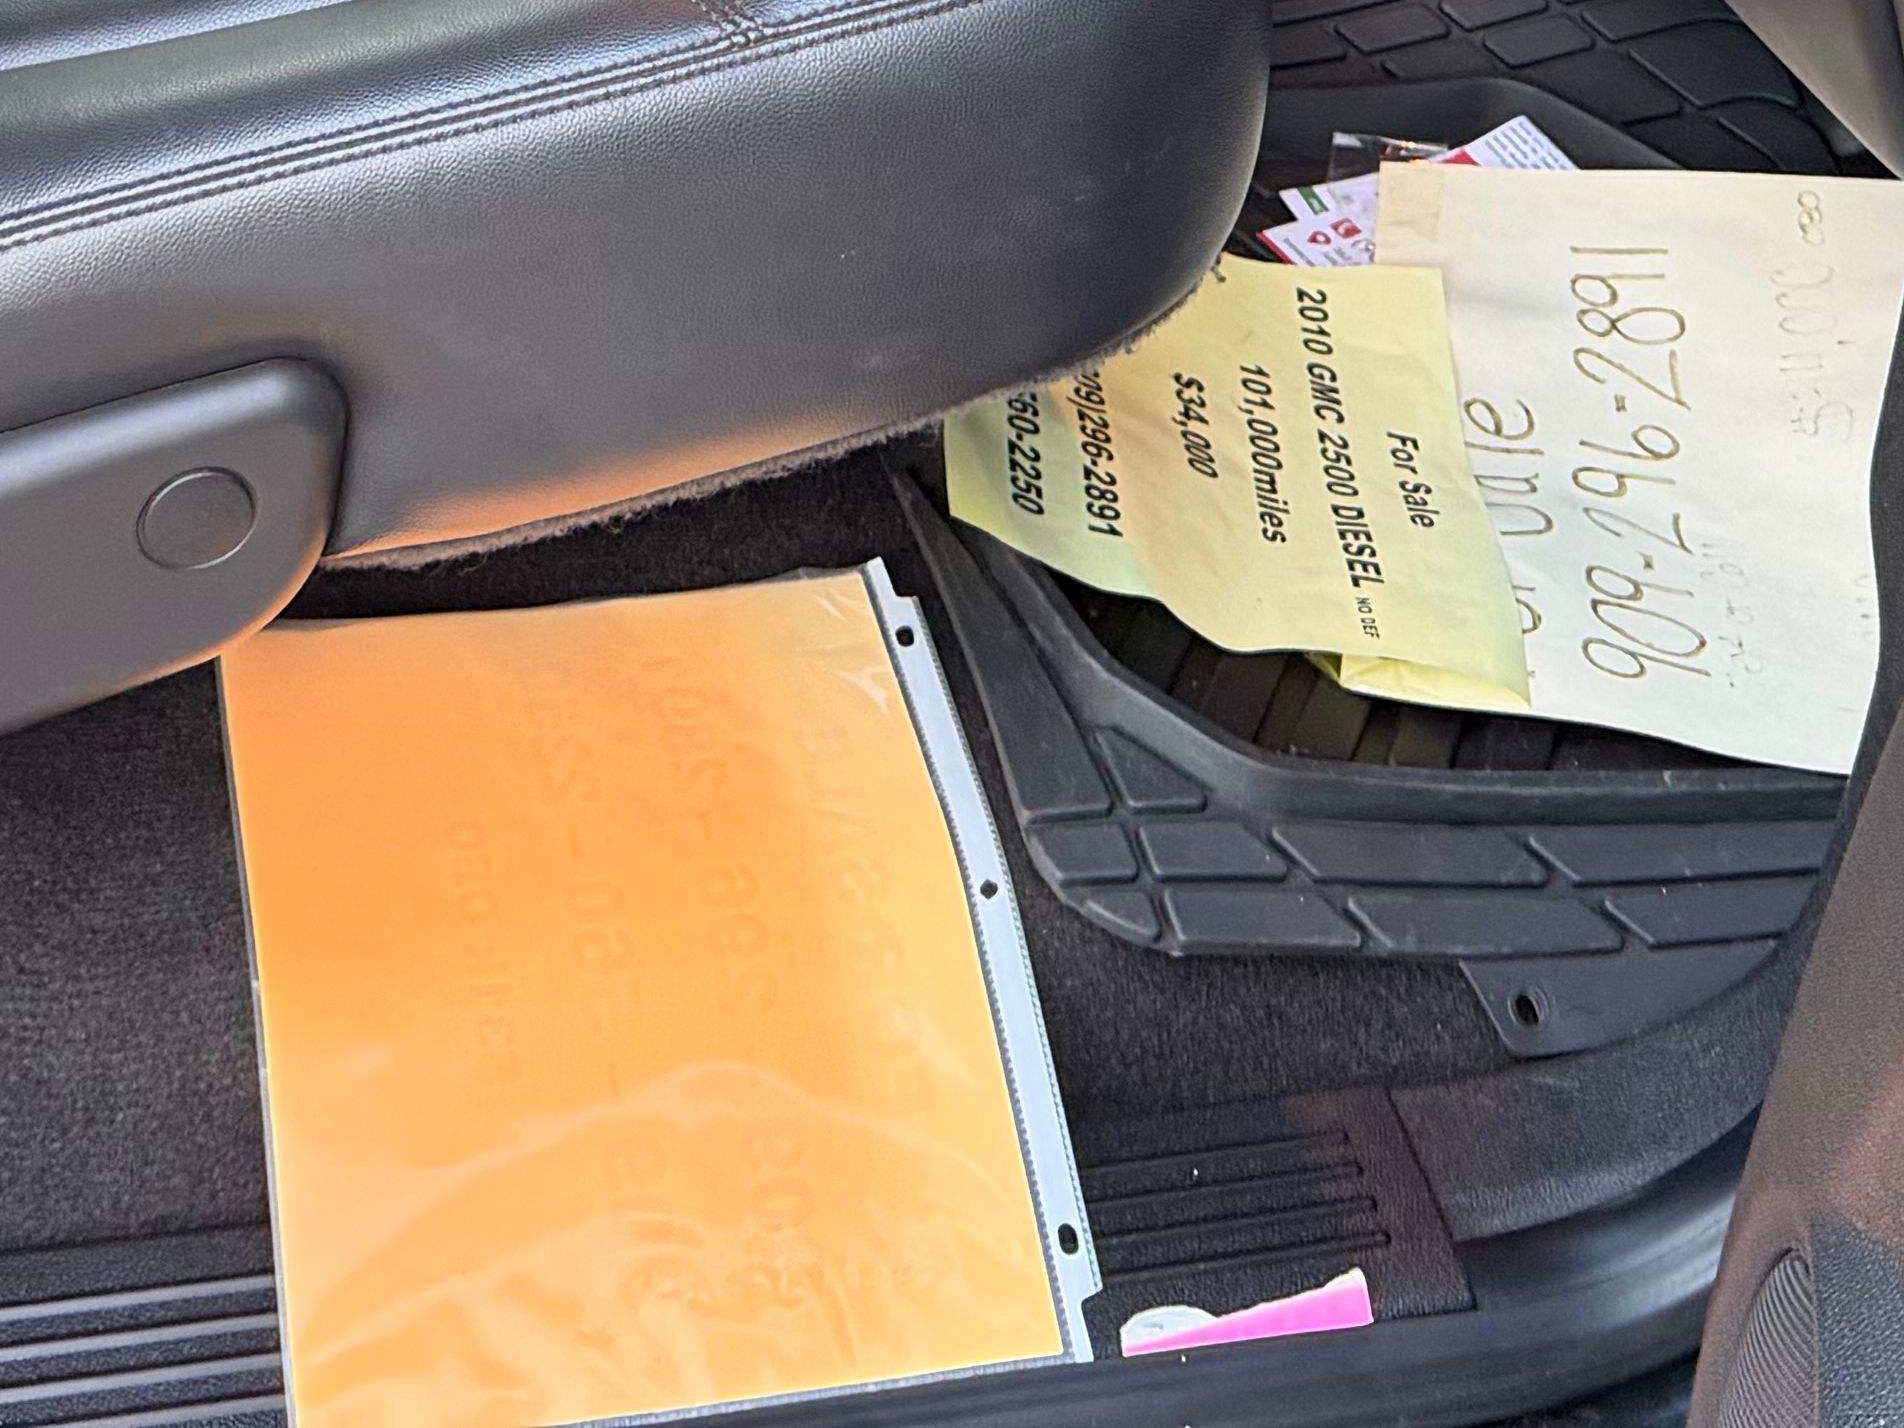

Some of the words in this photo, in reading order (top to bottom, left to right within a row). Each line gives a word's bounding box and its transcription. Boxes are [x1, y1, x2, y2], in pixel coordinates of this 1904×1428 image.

[1296, 286, 1334, 356] 2010
[1171, 371, 1219, 479] $34,000
[1307, 361, 1345, 425] GMC
[1066, 372, 1124, 538] 09)296-2891
[1239, 363, 1290, 544] 101,000miles
[1317, 428, 1359, 498] 2500
[1386, 430, 1419, 474] For
[1569, 245, 1712, 679] 909-296-2891
[1398, 480, 1440, 529] Sale
[1330, 504, 1385, 588] DIESEL
[1355, 596, 1373, 615] NO
[1359, 618, 1381, 639] DEF
